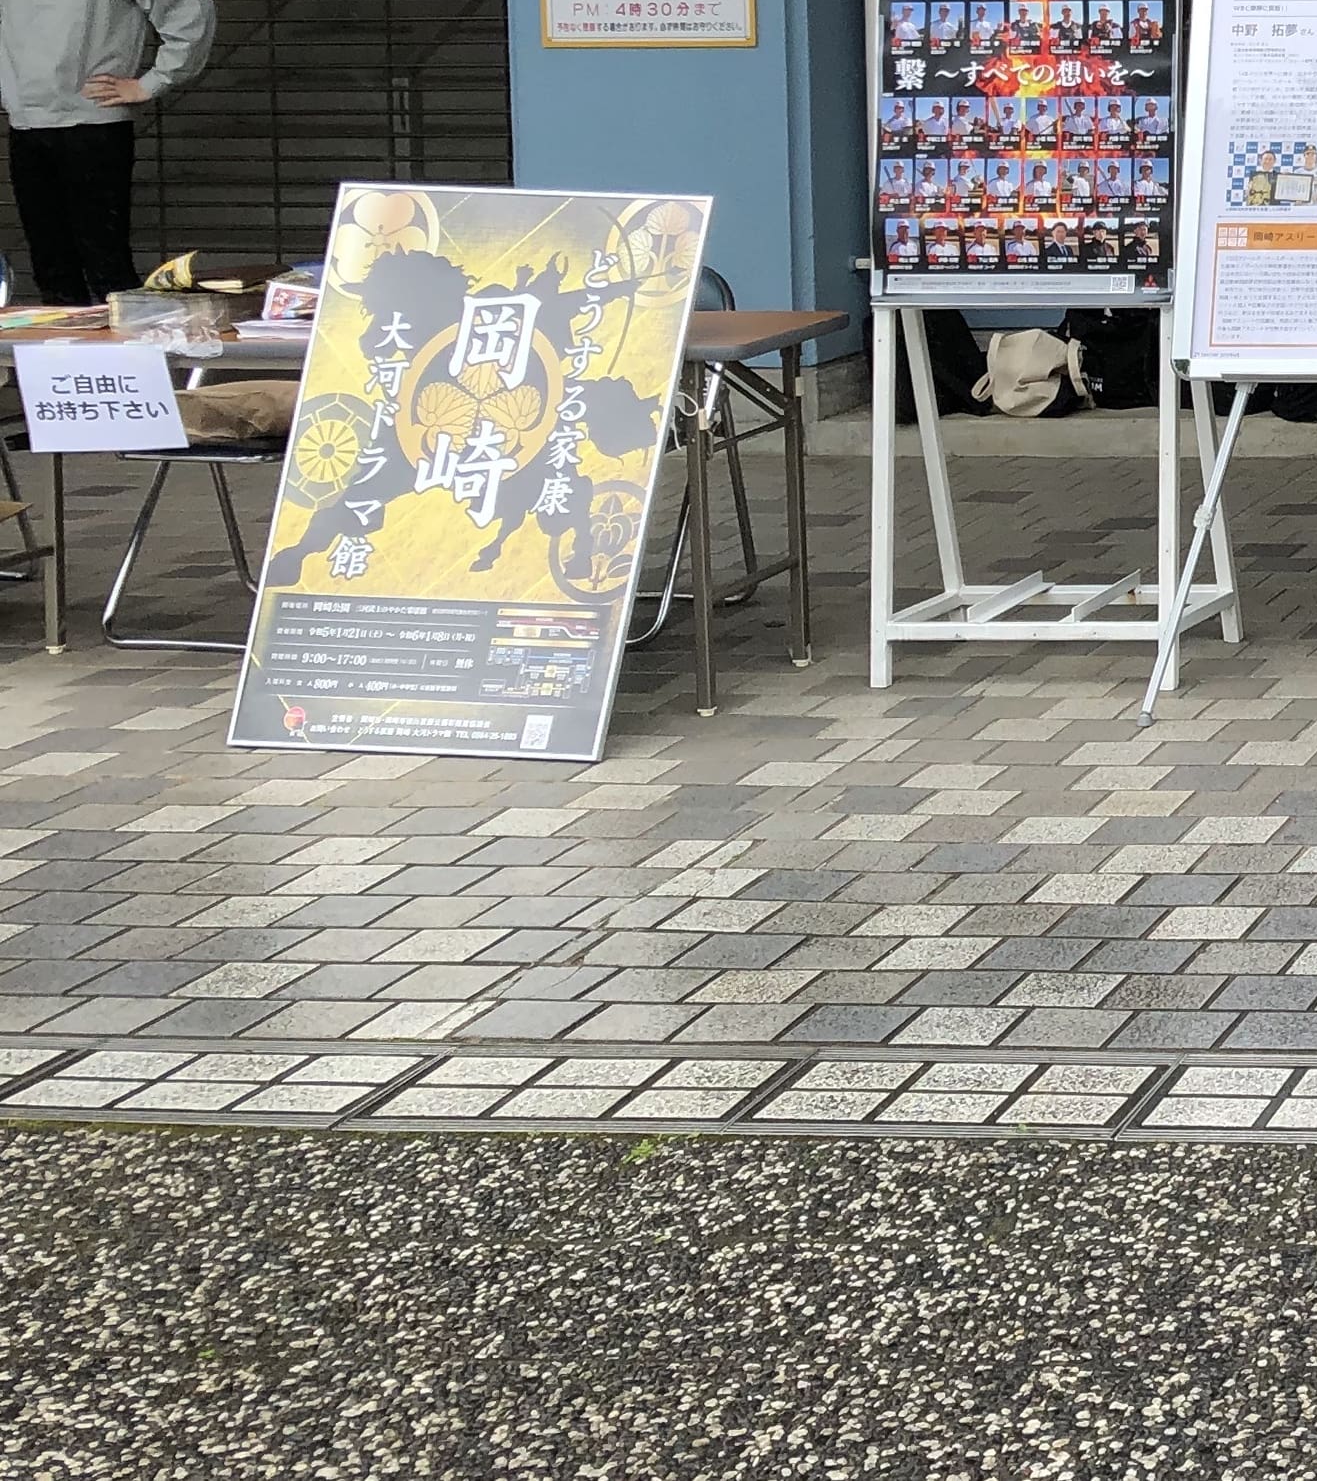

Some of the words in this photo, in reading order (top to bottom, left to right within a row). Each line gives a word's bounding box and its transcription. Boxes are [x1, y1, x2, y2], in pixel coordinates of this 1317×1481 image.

[1232, 23, 1258, 37] 中野
[35, 400, 170, 421] お持ち下さい
[51, 374, 139, 395] ご自由に
[329, 311, 413, 579] 大河ドラマ館
[414, 293, 541, 529] 岡崎
[529, 249, 620, 516] どうする家康
